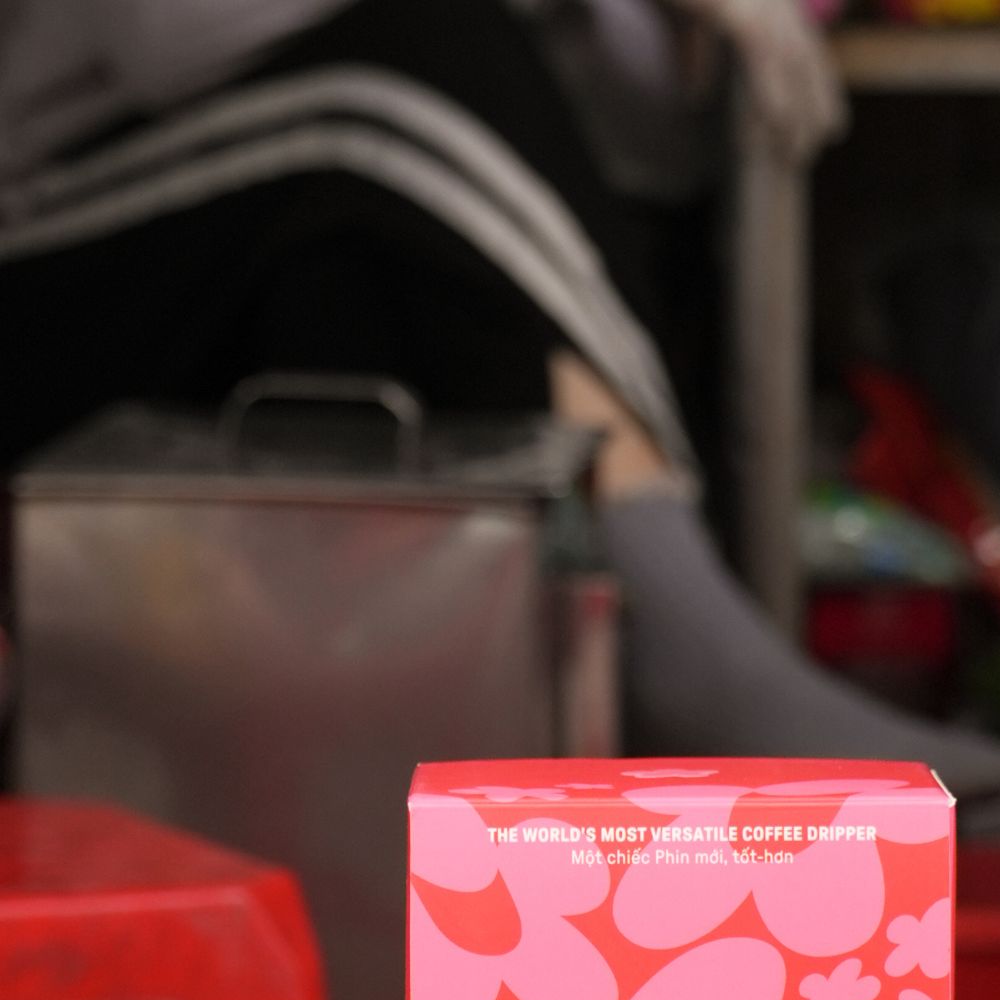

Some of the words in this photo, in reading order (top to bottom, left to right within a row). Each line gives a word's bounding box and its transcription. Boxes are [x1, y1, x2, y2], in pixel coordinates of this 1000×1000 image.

[487, 827, 518, 843] THE
[523, 827, 596, 843] WORLD'S
[601, 827, 647, 843] MOST
[651, 826, 738, 842] VERSATILE
[742, 826, 803, 842] COFFEE
[807, 825, 877, 841] DRIPPER
[571, 849, 603, 867] Một
[607, 847, 650, 865] chiếc
[655, 849, 690, 864] Phin
